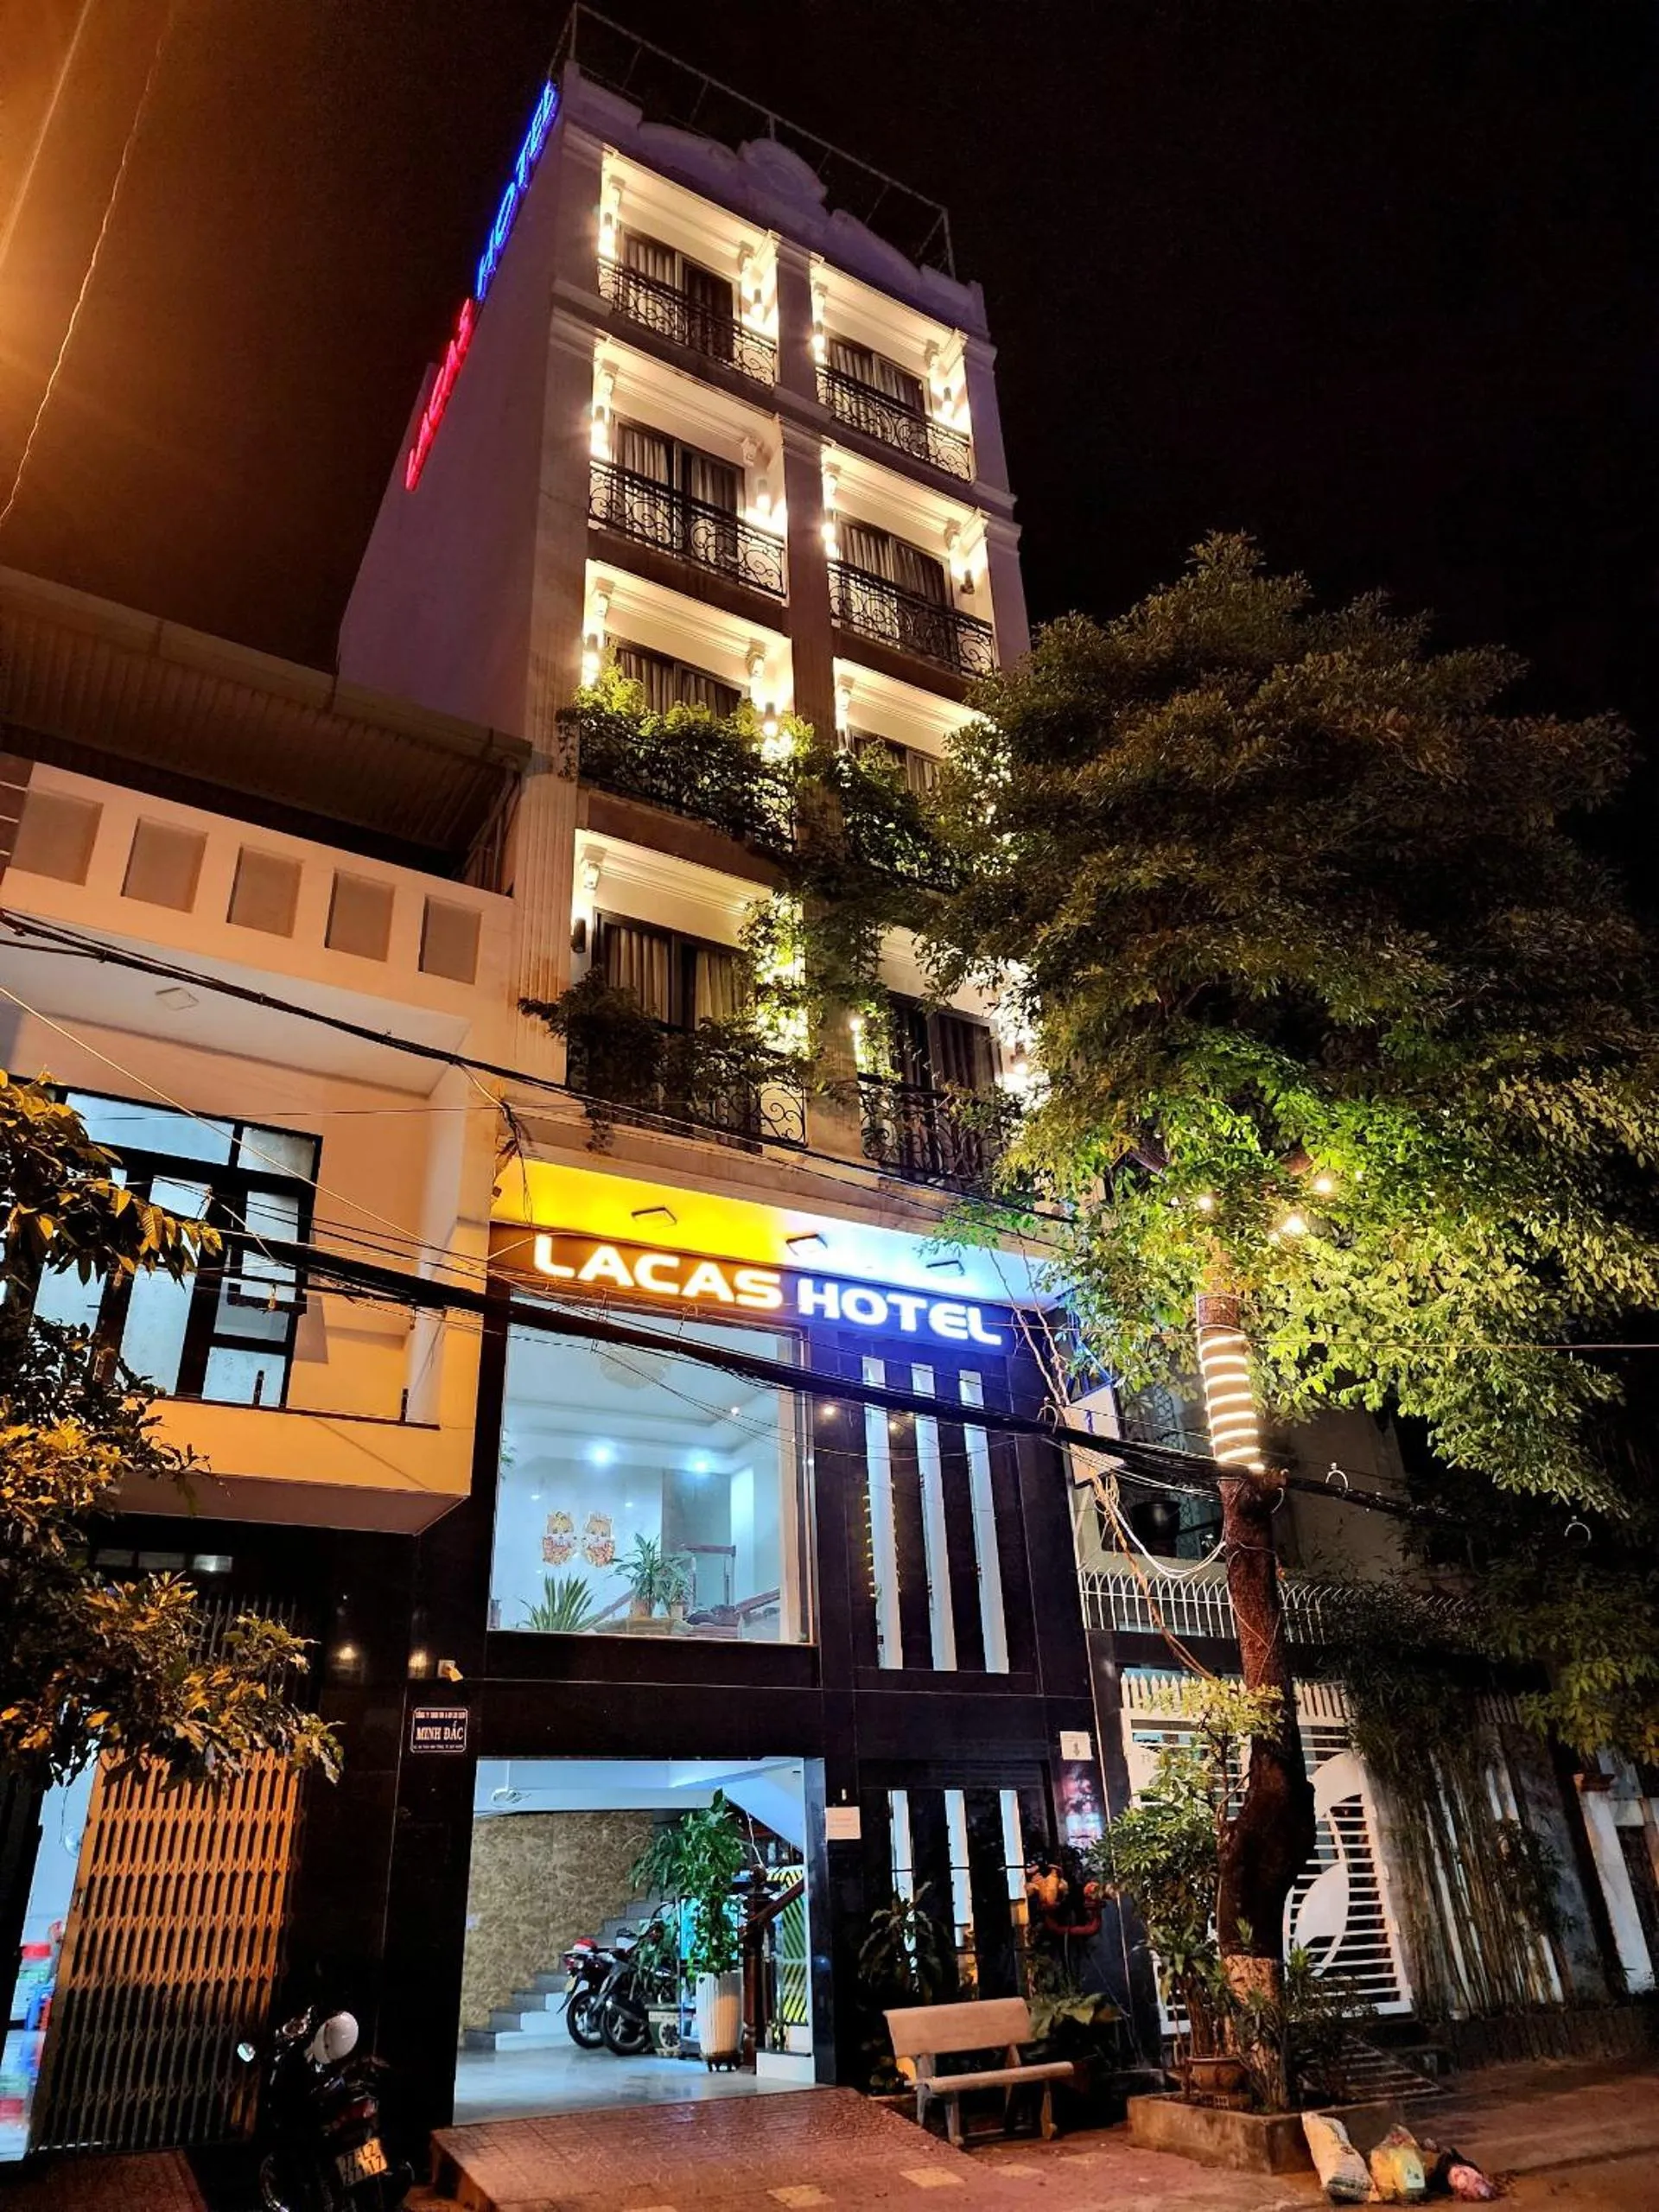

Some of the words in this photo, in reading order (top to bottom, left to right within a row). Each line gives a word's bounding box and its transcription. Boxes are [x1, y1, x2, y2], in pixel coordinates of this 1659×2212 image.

[534, 1234, 783, 1308] LACAS
[798, 1278, 1002, 1345] HOTEL
[416, 1726, 442, 1740] MINH
